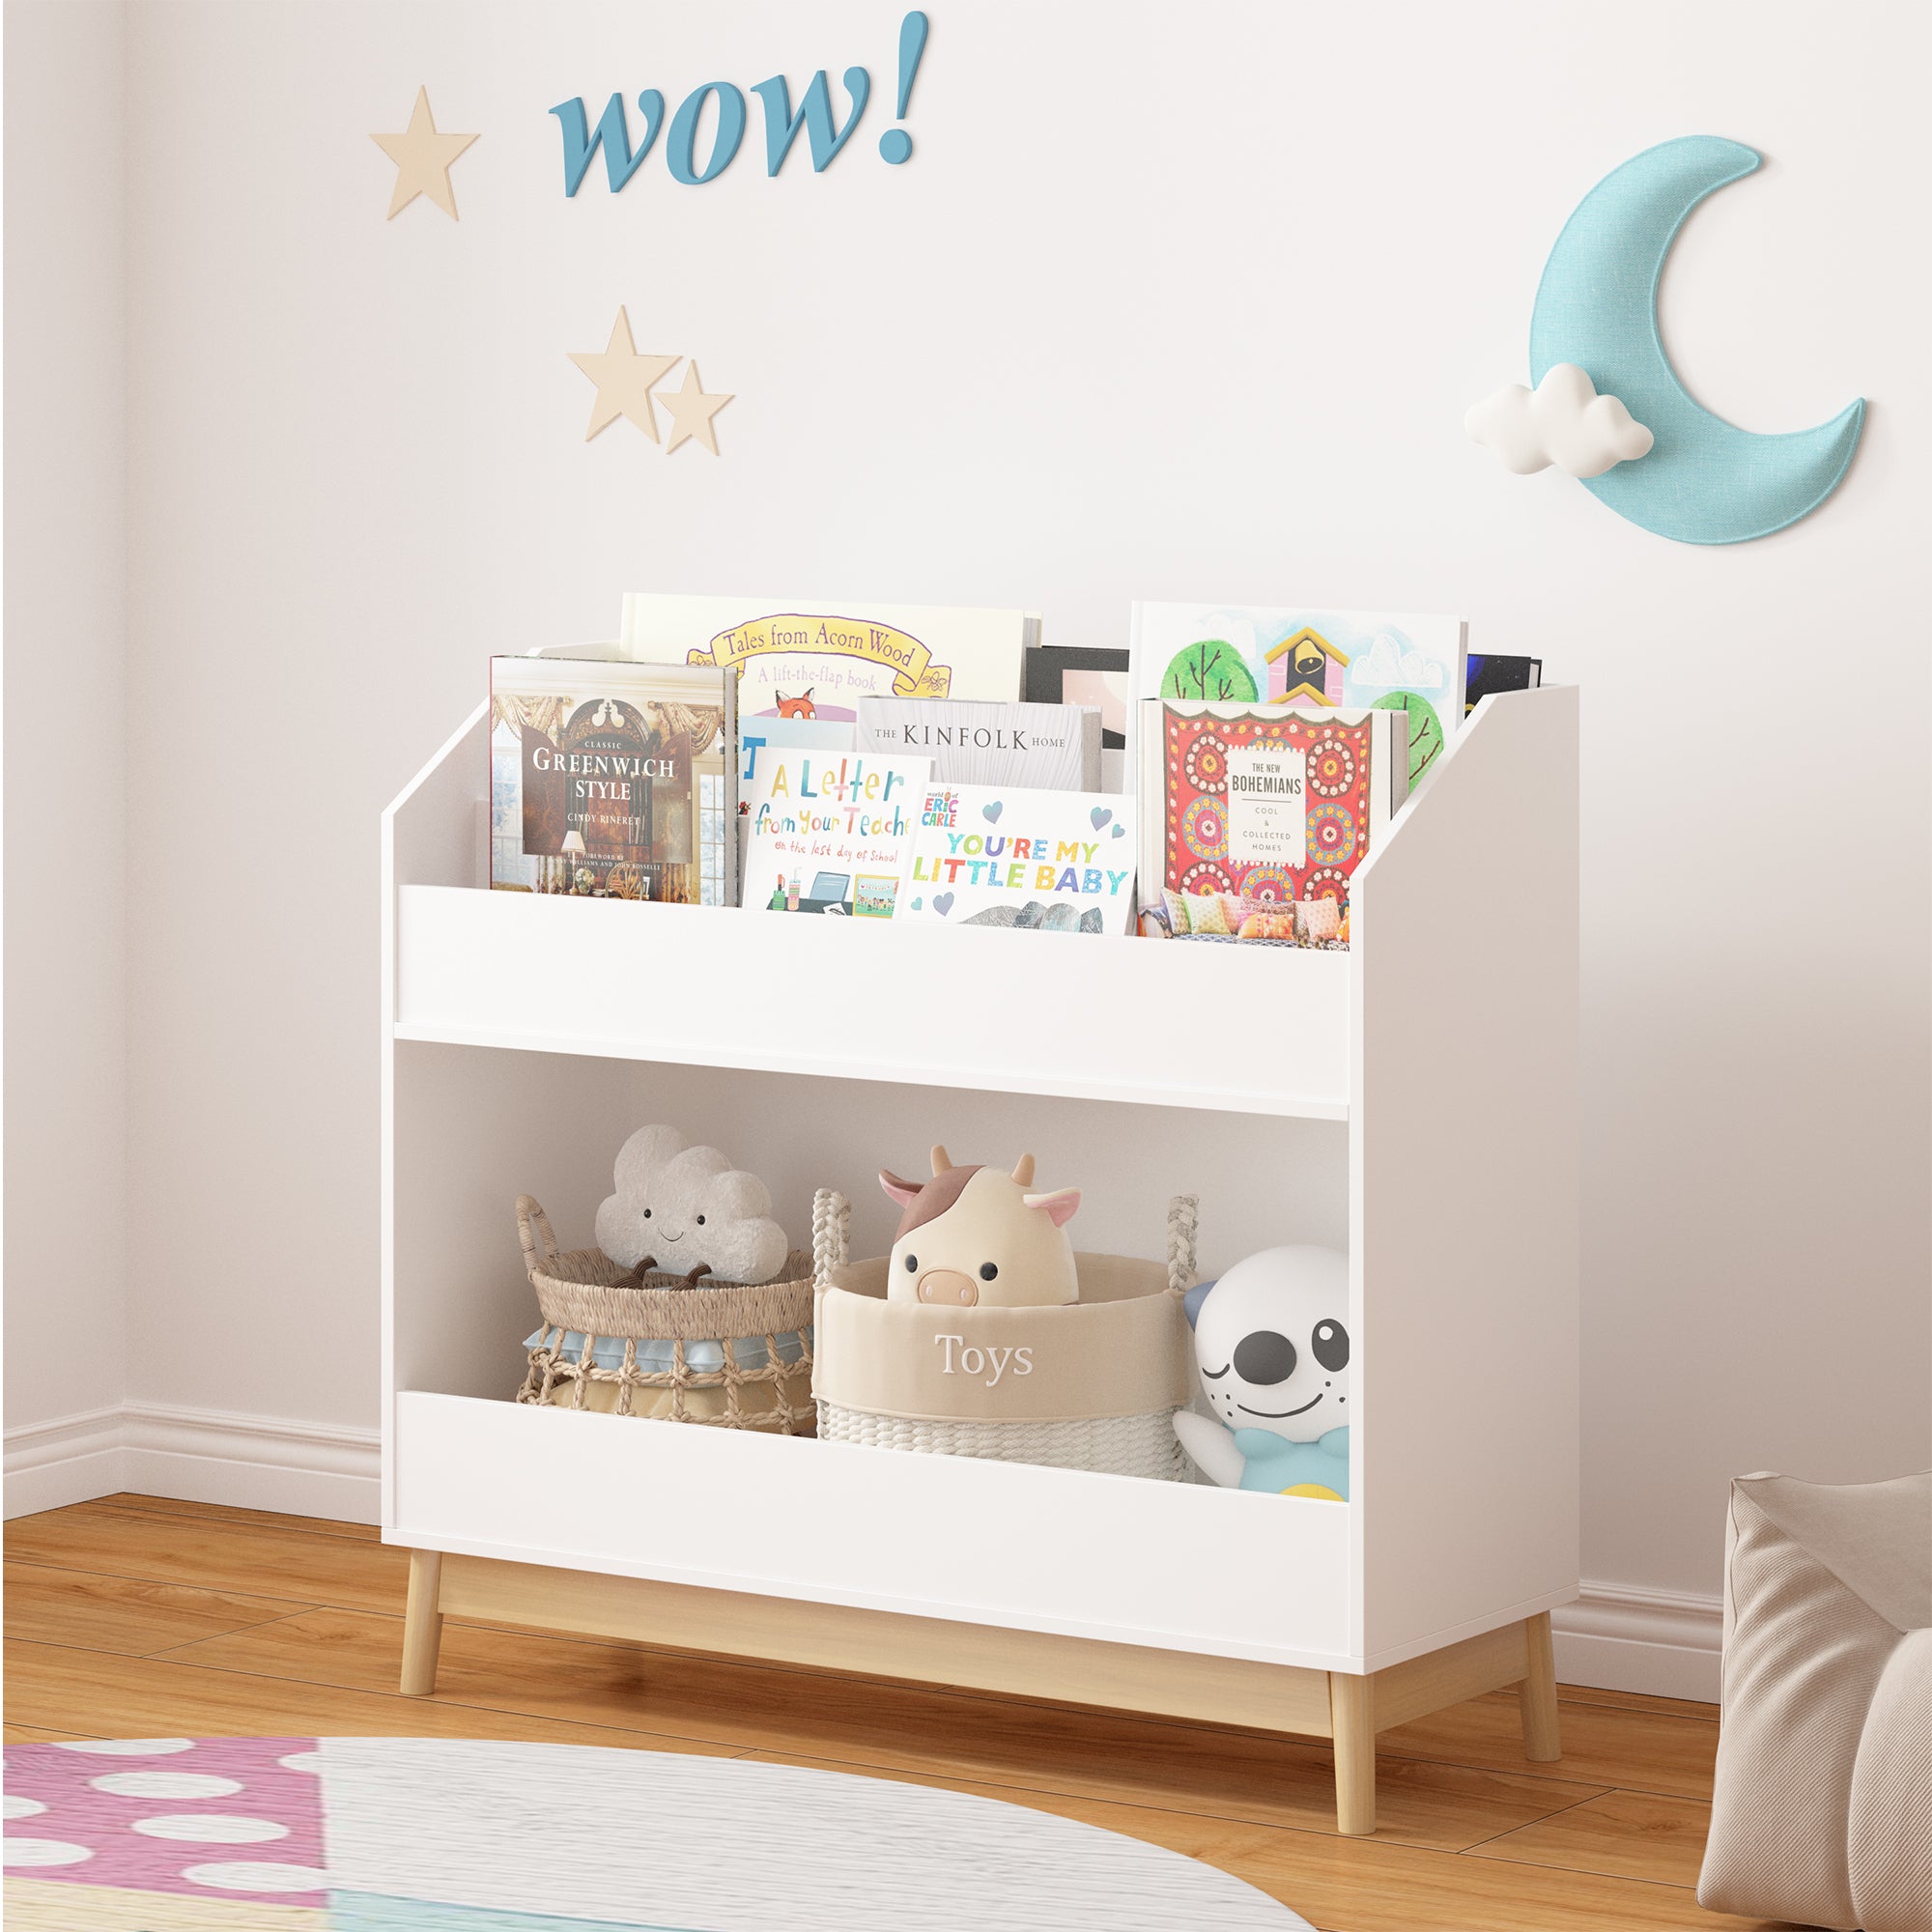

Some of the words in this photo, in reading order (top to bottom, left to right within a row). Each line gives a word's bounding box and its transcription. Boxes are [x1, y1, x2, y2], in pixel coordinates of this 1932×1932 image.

[549, 11, 928, 198] wow!
[723, 631, 765, 656] Tales
[771, 624, 809, 645] from
[815, 622, 863, 650] Acorn
[869, 629, 916, 668] Wood
[757, 668, 769, 683] A
[773, 666, 843, 688] lift-the-flap
[847, 672, 877, 691] book
[584, 740, 622, 750] CLASSIC
[875, 728, 897, 739] THE
[903, 724, 1028, 751] KINFOLK
[1032, 737, 1065, 748] HOME
[532, 747, 674, 778] GREENWICH
[1252, 762, 1264, 773] THE
[1265, 763, 1281, 774] NEW
[576, 780, 632, 801] STYLE
[770, 764, 789, 799] A
[800, 758, 905, 803] Letter
[1232, 775, 1302, 795] BOHEMIANS
[567, 812, 597, 822] CINDY
[600, 814, 640, 826] RINFRET
[754, 803, 796, 836] from
[799, 810, 840, 835] your
[921, 811, 957, 828] CARLE
[1255, 807, 1279, 815] COOL
[1242, 830, 1292, 840] COLLECTED
[775, 840, 787, 850] on
[790, 840, 806, 854] the
[811, 839, 832, 856] last
[837, 844, 853, 863] day
[856, 850, 868, 862] of
[947, 833, 1049, 861] YOU'RE
[1056, 840, 1100, 864] MY
[1252, 843, 1282, 852] HOMES
[912, 856, 1027, 889] LITTLE
[1035, 865, 1129, 896] BABY
[934, 1334, 1034, 1388] Toys
